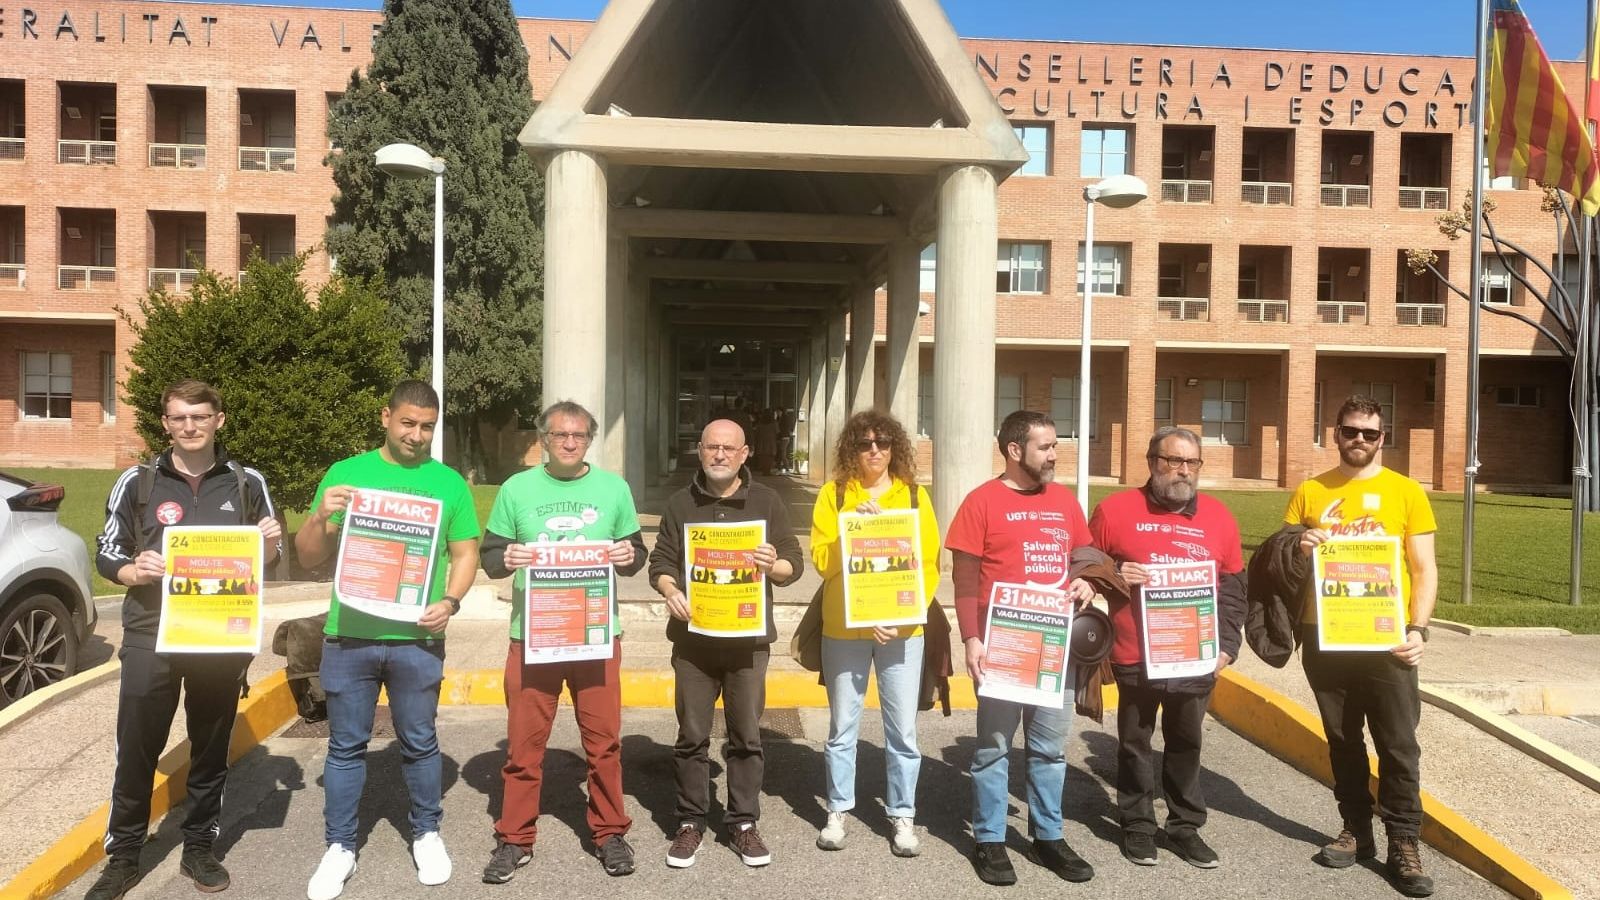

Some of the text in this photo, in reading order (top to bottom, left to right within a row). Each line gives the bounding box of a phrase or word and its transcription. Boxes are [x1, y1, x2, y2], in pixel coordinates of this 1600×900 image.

[1265, 61, 1476, 98] D'EDUCA
[997, 87, 1204, 120] CULTURA
[1244, 94, 1249, 122] I
[358, 494, 432, 521] 31 MARÇ
[536, 501, 598, 517] ESTIME
[1006, 511, 1027, 521] UGT
[355, 518, 430, 536] VAGA EDUCATIVA
[847, 521, 861, 531] 24
[1136, 523, 1160, 532] UGT
[691, 530, 706, 540] 24
[171, 536, 189, 548] 24
[192, 535, 250, 543] CONCENTRACIONS
[1023, 541, 1060, 552] Salvem
[1321, 545, 1336, 555] 24
[536, 547, 604, 565] 31 MARÇ
[1024, 552, 1062, 563] l'escola
[1150, 553, 1194, 564] Salvem
[535, 570, 606, 579] VAGA EDUCATIVA
[1025, 564, 1062, 574] pública
[1150, 570, 1208, 586] 31 MARÇ
[1149, 589, 1211, 599] VAGA EDUCATIVA
[1000, 588, 1064, 612] 31 MARÇ
[997, 609, 1065, 625] VAGA EDUCATIVA
